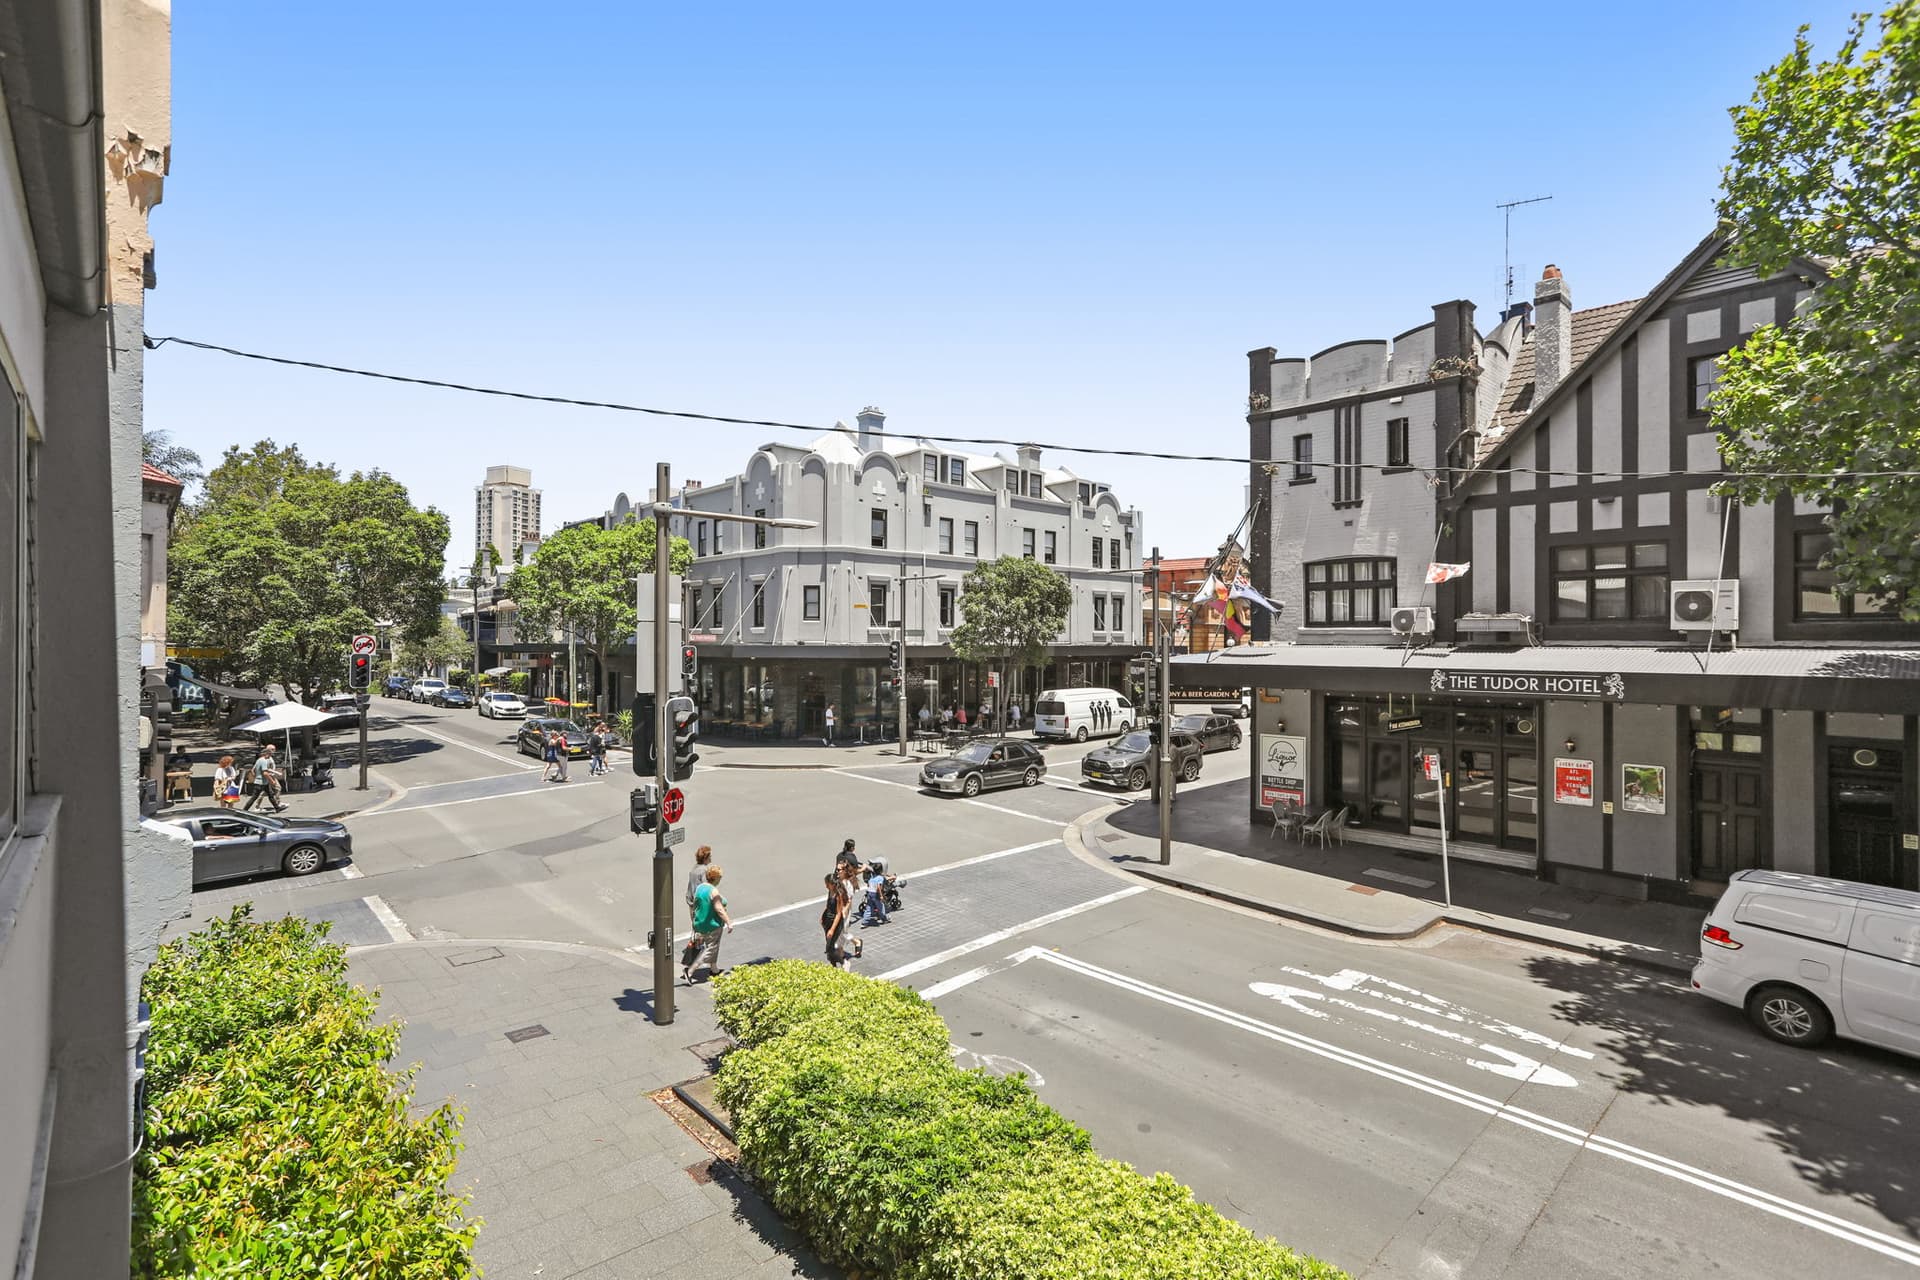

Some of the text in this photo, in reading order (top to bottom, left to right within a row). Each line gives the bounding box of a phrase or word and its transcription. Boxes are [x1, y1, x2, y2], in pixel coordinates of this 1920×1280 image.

[1449, 675, 1601, 693] THE TUDOR HOTEL
[664, 797, 683, 815] STOP
